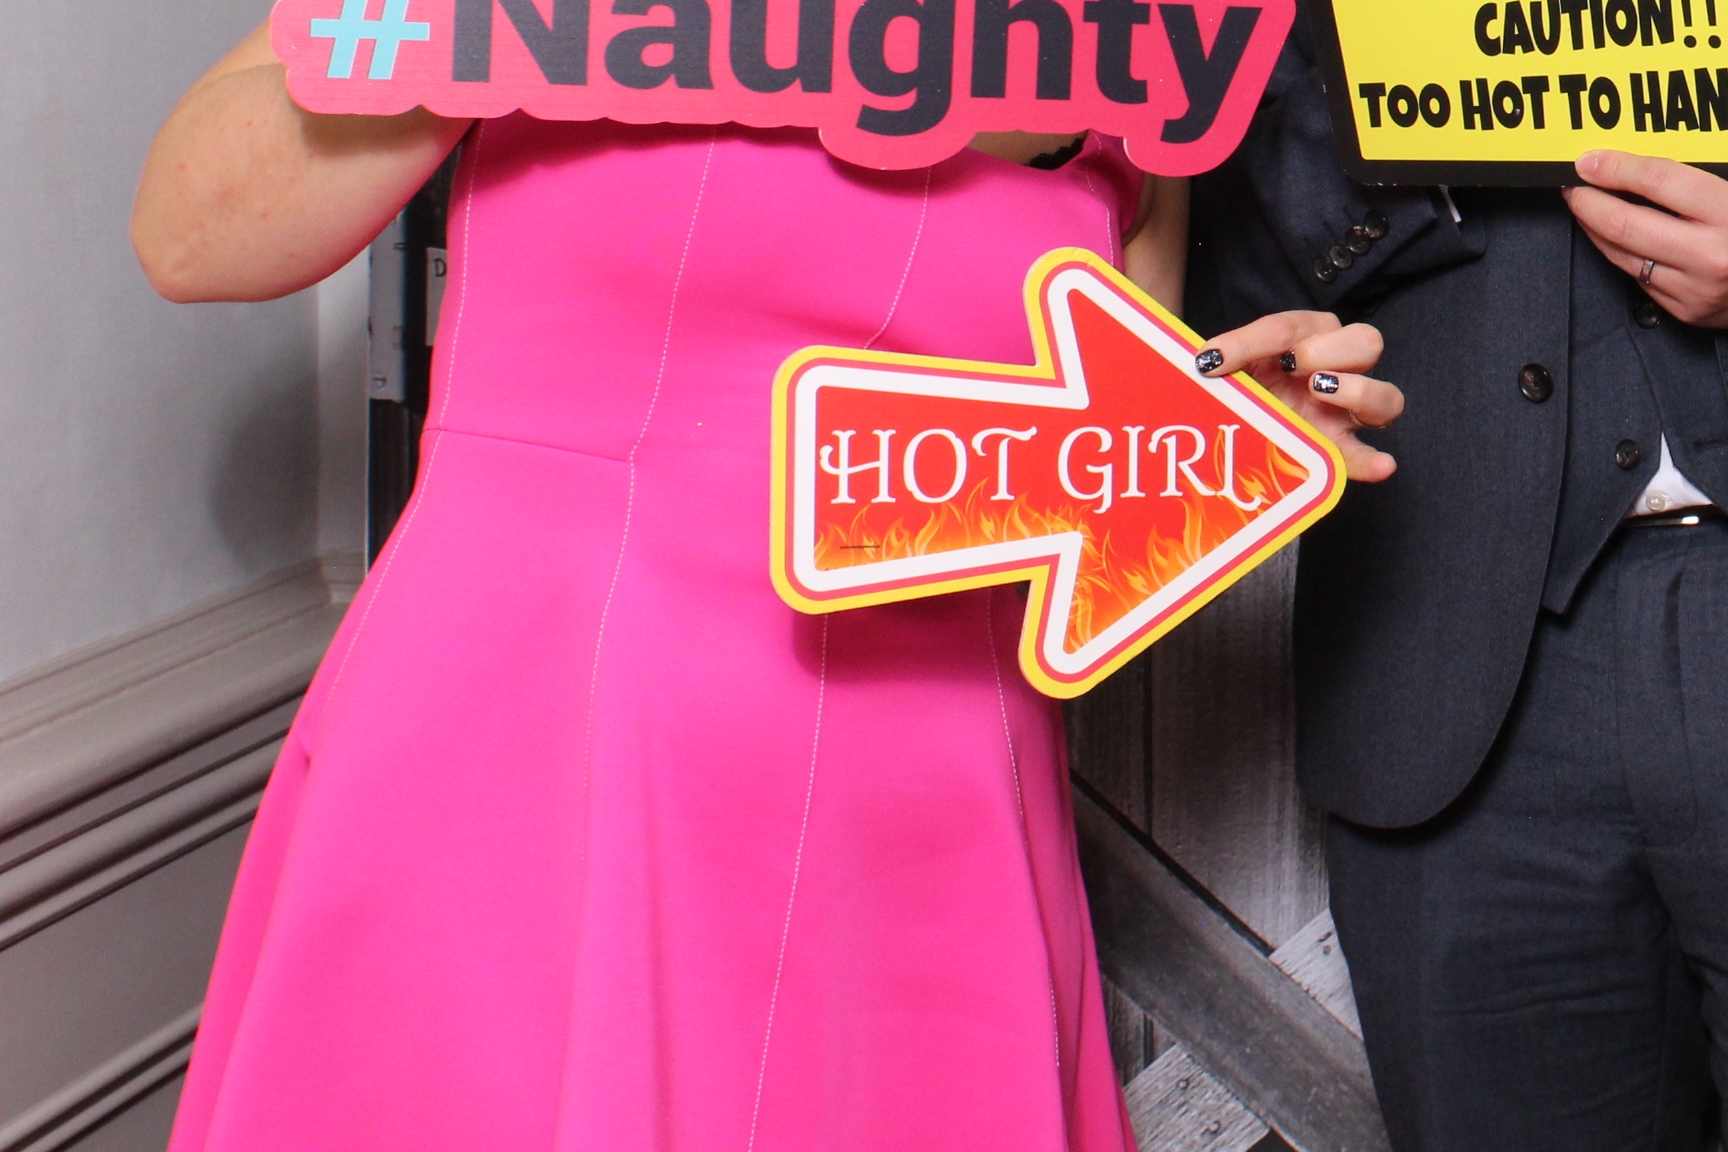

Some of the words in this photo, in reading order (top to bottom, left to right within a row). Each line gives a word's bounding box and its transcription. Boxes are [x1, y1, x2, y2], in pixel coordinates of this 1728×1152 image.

[1358, 79, 1451, 129] TOO
[1459, 75, 1552, 131] HOT
[1559, 73, 1621, 131] TO
[819, 426, 1038, 506] HOT
[1057, 423, 1262, 515] GIRL
